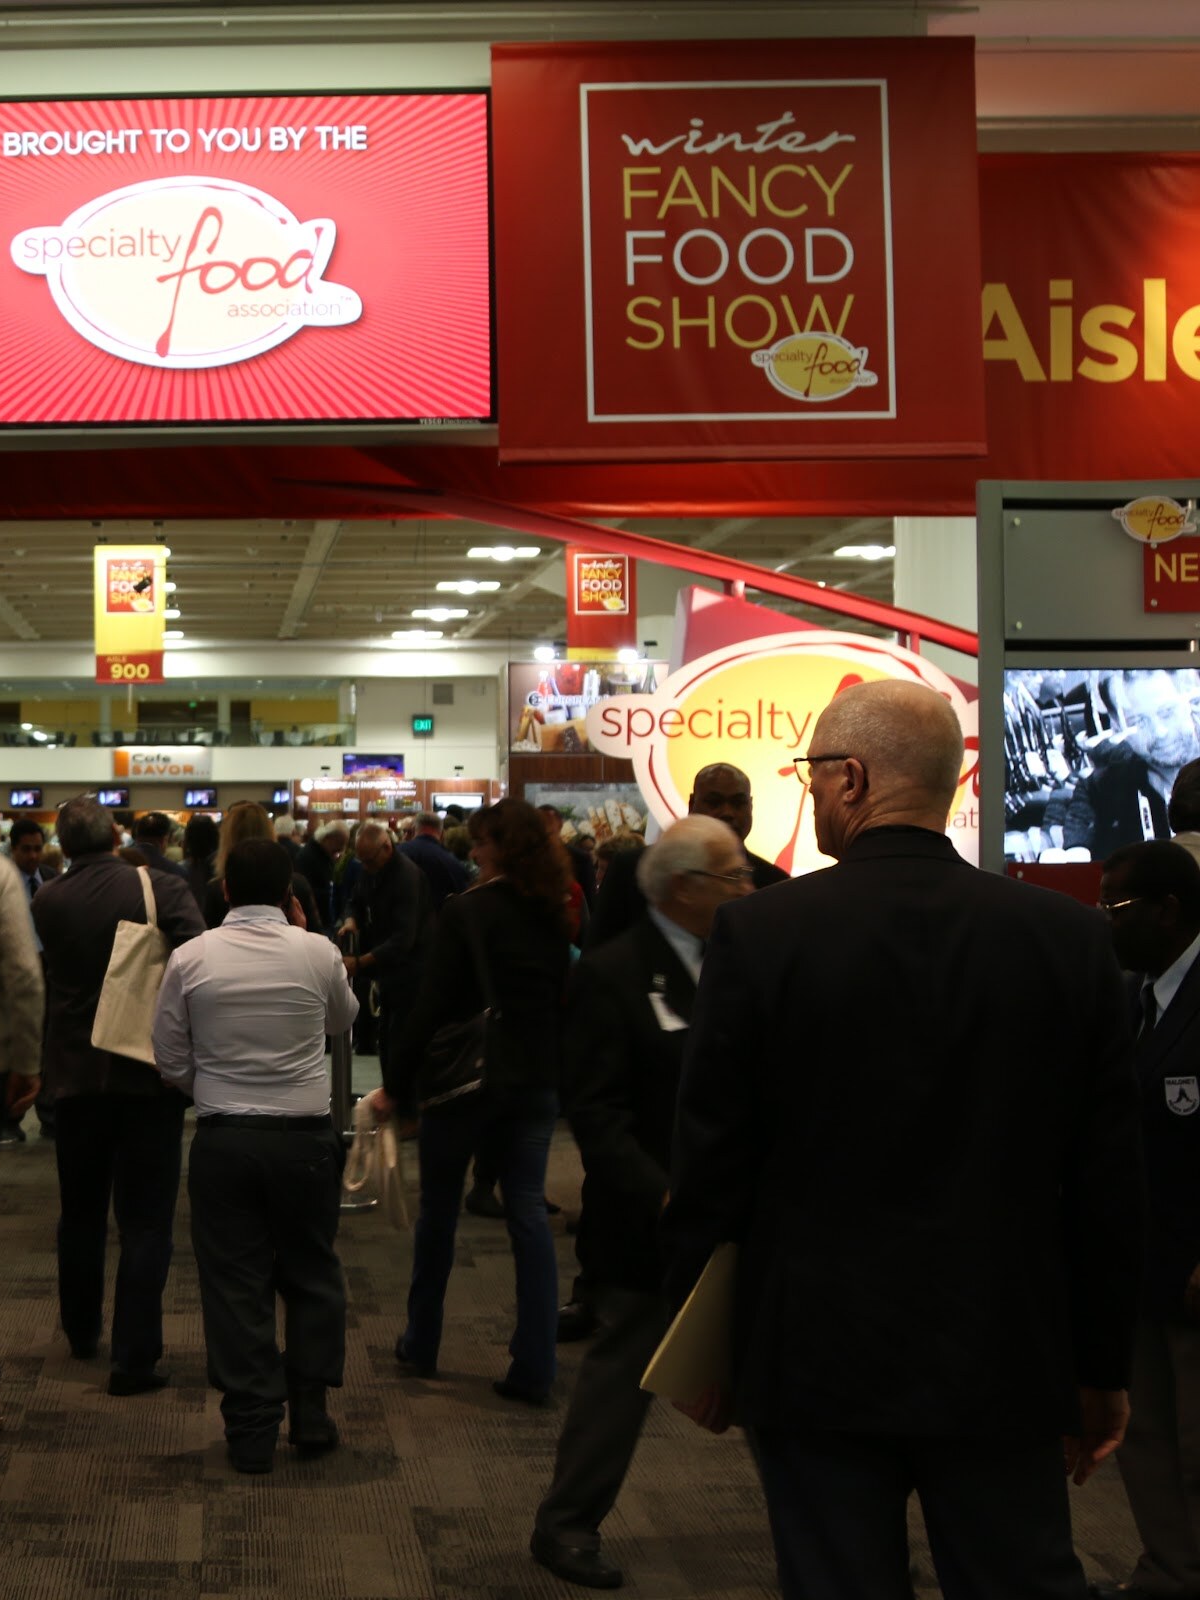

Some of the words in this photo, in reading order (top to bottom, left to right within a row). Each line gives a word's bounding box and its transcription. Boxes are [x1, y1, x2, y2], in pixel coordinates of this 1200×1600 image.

[3, 128, 142, 157] BROUGHT
[150, 127, 191, 154] TO
[198, 126, 262, 153] YOU
[270, 125, 307, 151] BY
[315, 125, 367, 150] THE
[620, 111, 856, 156] winter
[621, 163, 855, 220] FANCY
[625, 226, 855, 287] FOOD
[23, 227, 182, 264] specialty
[156, 206, 325, 357] food
[227, 299, 341, 319] association
[625, 294, 856, 351] SHOW
[804, 342, 865, 398] food
[581, 568, 623, 579] FANCY
[1155, 553, 1200, 582] NE
[581, 579, 623, 591] FOOD
[581, 590, 623, 603] SHOW
[111, 663, 150, 679] 900
[414, 718, 433, 732] EXIT
[600, 699, 813, 750] specialty
[132, 753, 171, 763] Cafe
